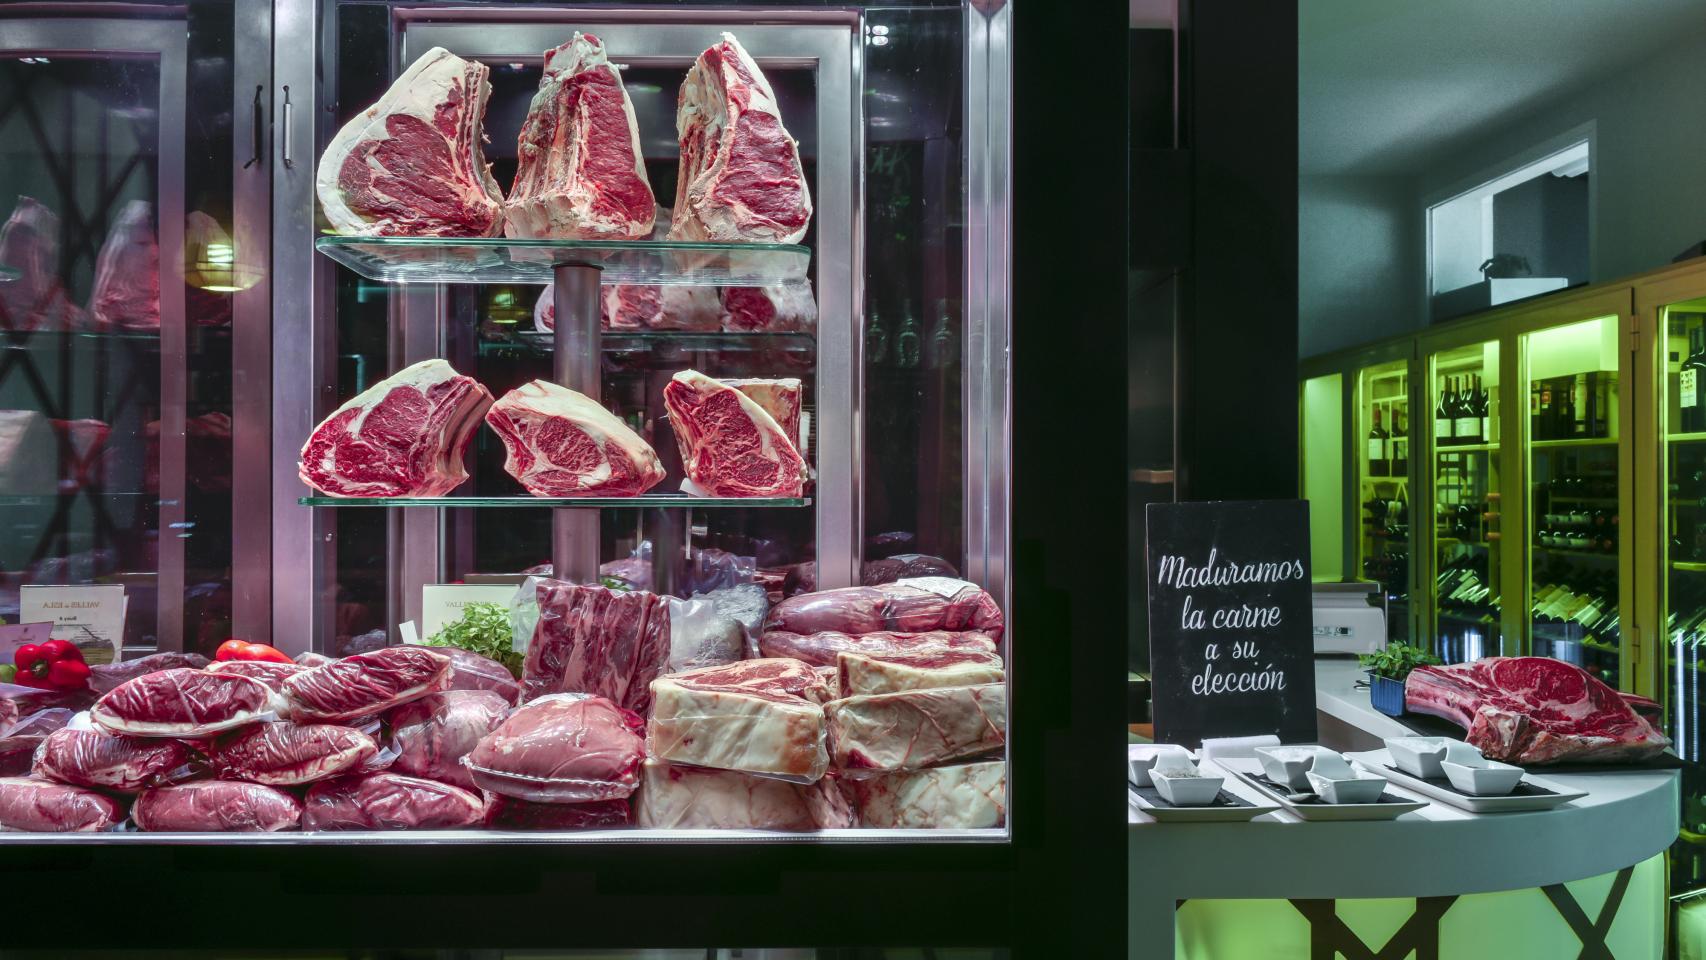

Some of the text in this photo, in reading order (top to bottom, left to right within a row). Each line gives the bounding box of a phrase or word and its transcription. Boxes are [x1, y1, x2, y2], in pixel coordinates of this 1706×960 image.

[1158, 548, 1304, 588] Maduramos
[1182, 595, 1282, 629] la carne
[1205, 641, 1260, 660] a su
[1191, 663, 1287, 695] elección
